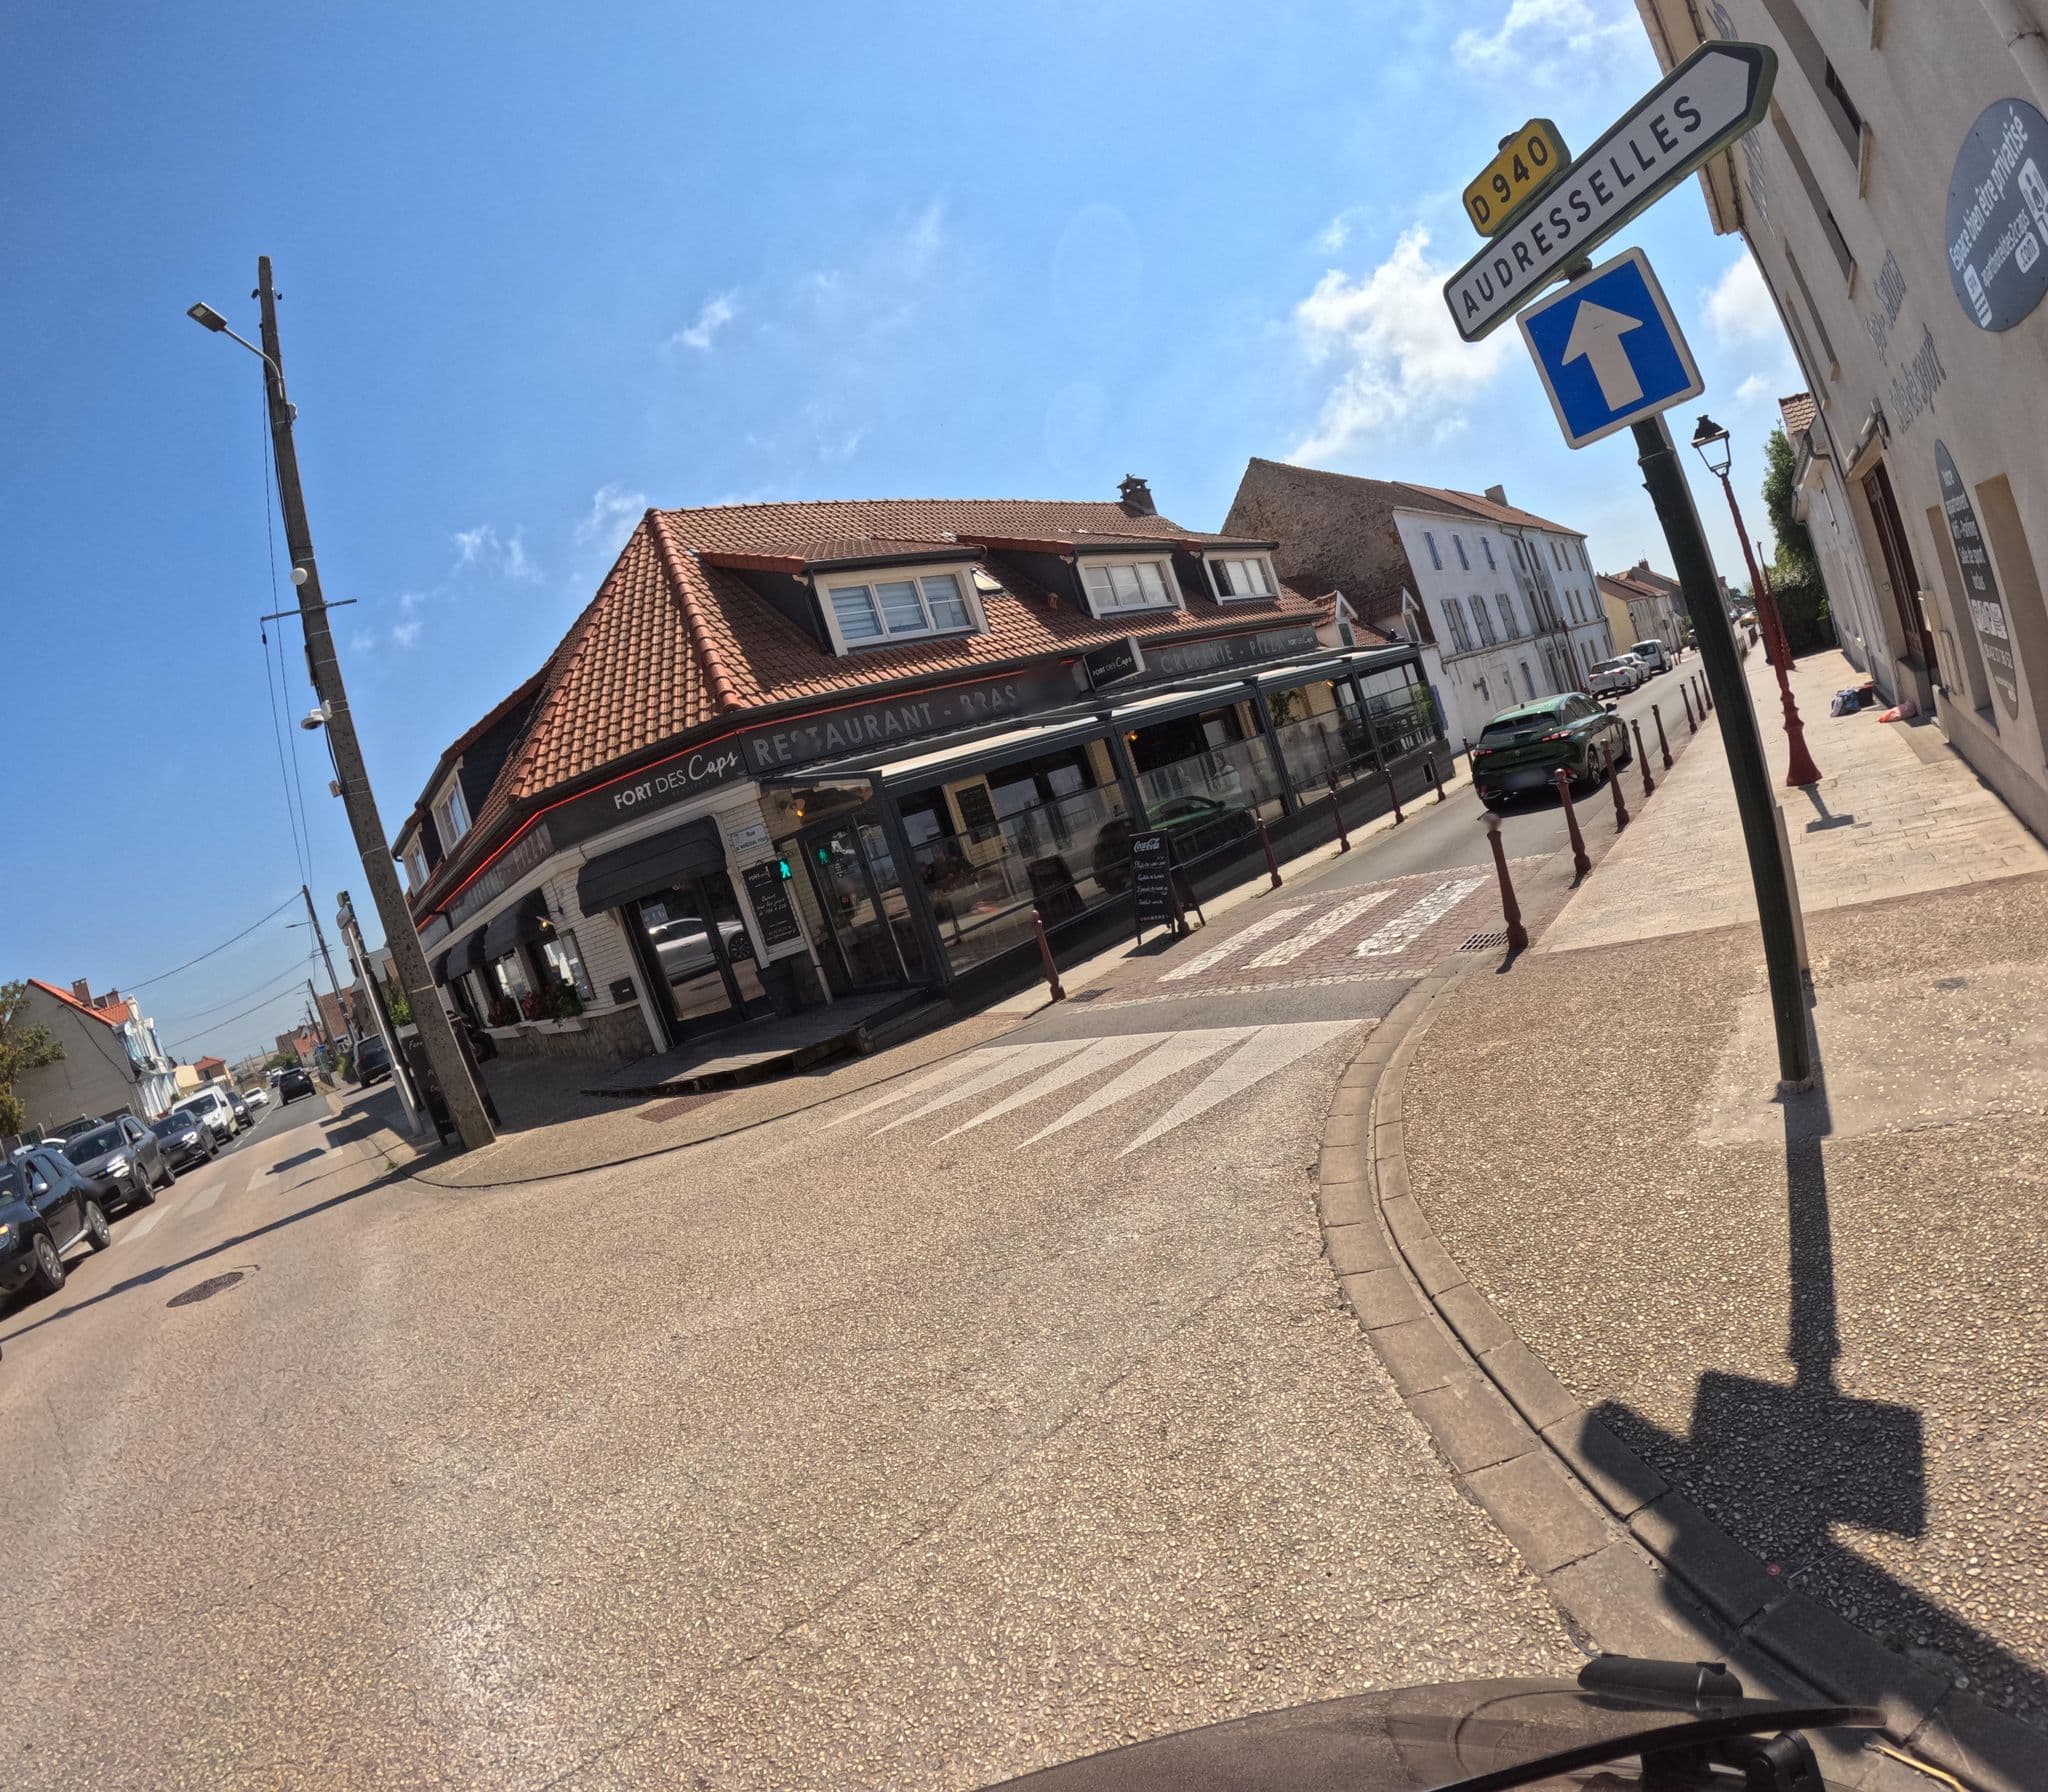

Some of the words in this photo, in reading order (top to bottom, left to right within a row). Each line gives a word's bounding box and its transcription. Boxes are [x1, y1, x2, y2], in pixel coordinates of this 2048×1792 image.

[1461, 95, 1702, 319] AUDRESSELLES
[1471, 194, 1491, 224] D
[1495, 136, 1549, 202] 940
[1949, 230, 1972, 272] Espace
[1963, 208, 1985, 243] bien
[1975, 182, 1999, 217] être
[1992, 104, 2028, 200] privatisé
[614, 783, 652, 810] FORT
[655, 770, 686, 793] DES
[688, 751, 738, 781] Caps
